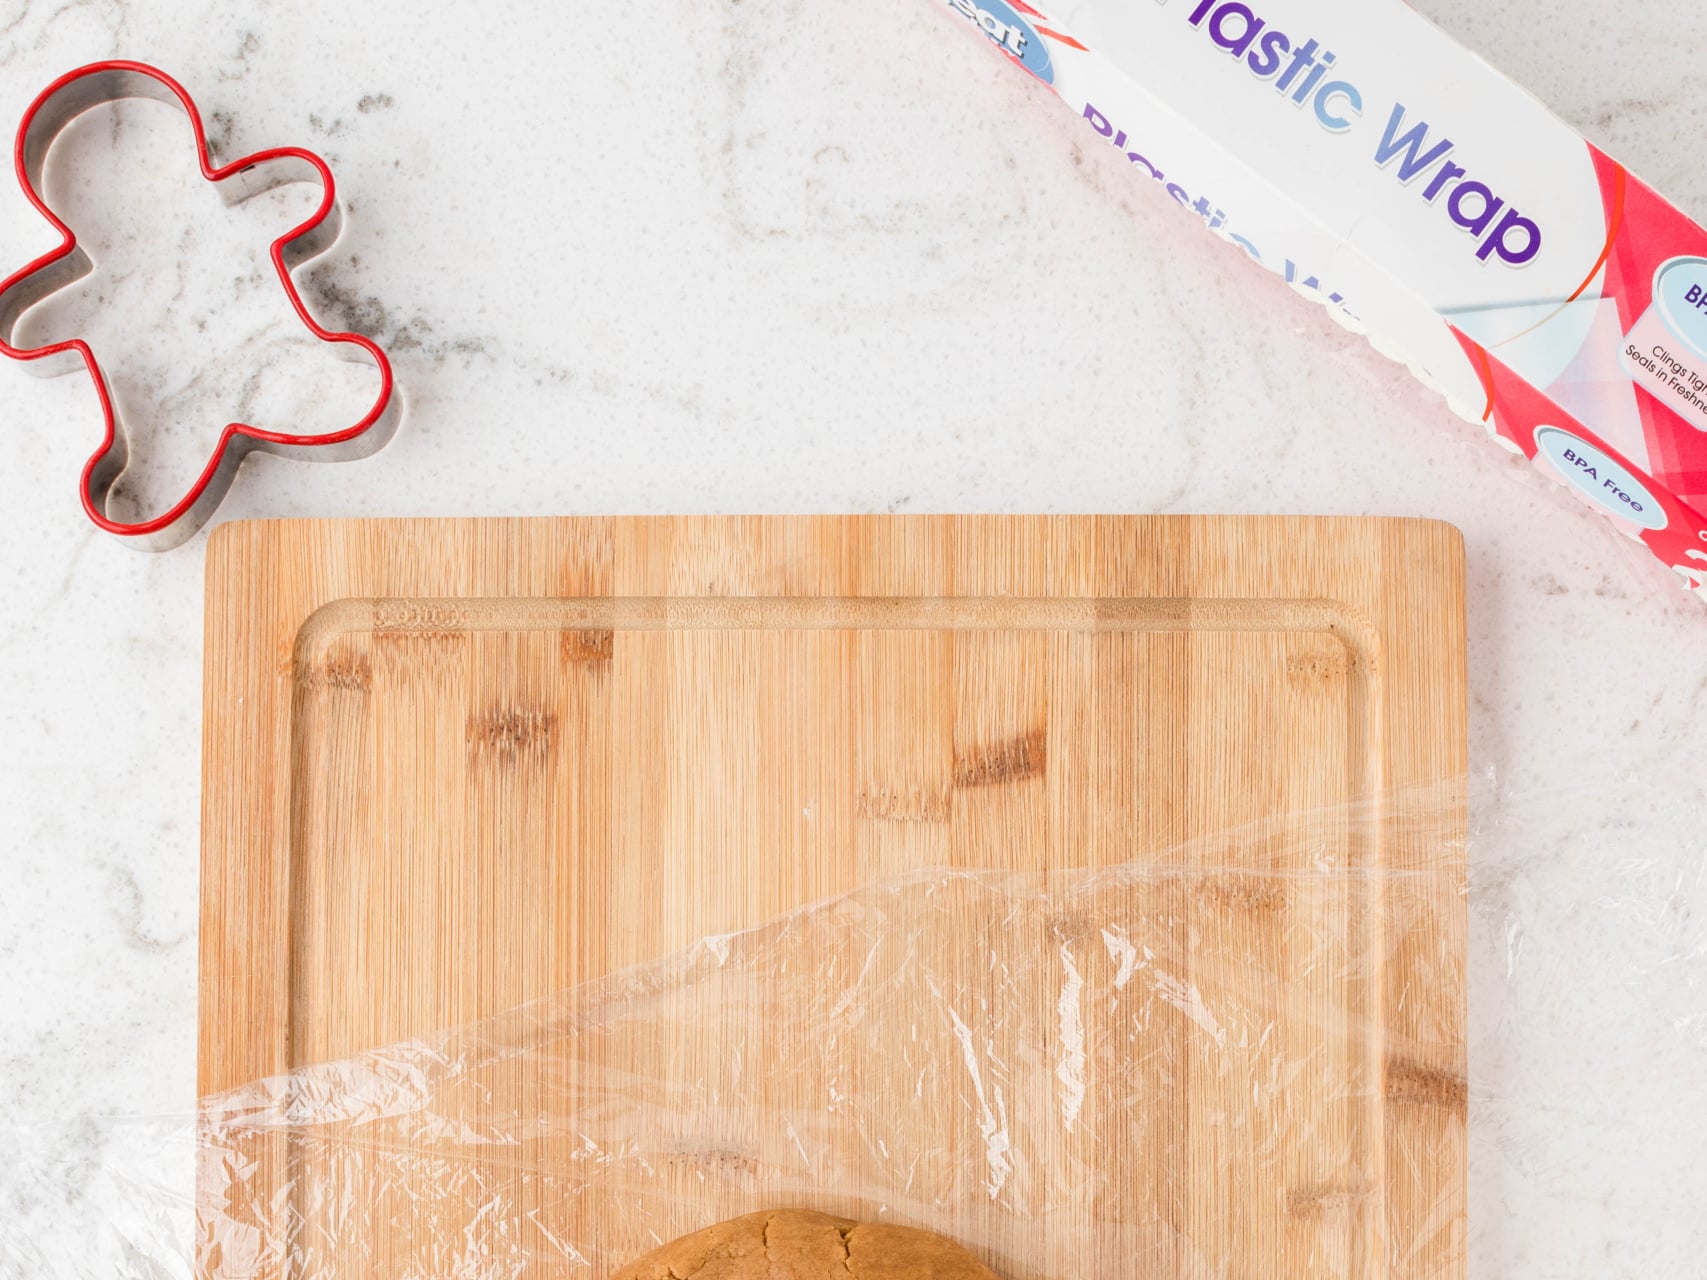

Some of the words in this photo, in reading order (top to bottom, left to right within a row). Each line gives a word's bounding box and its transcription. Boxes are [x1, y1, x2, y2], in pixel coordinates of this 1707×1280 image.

[1373, 101, 1542, 264] Wrap
[1684, 283, 1707, 315] BP
[1625, 344, 1657, 373] Seals
[1656, 367, 1668, 382] in
[1652, 345, 1688, 377] Clings
[1562, 448, 1597, 480] BPA
[1603, 479, 1644, 512] Free
